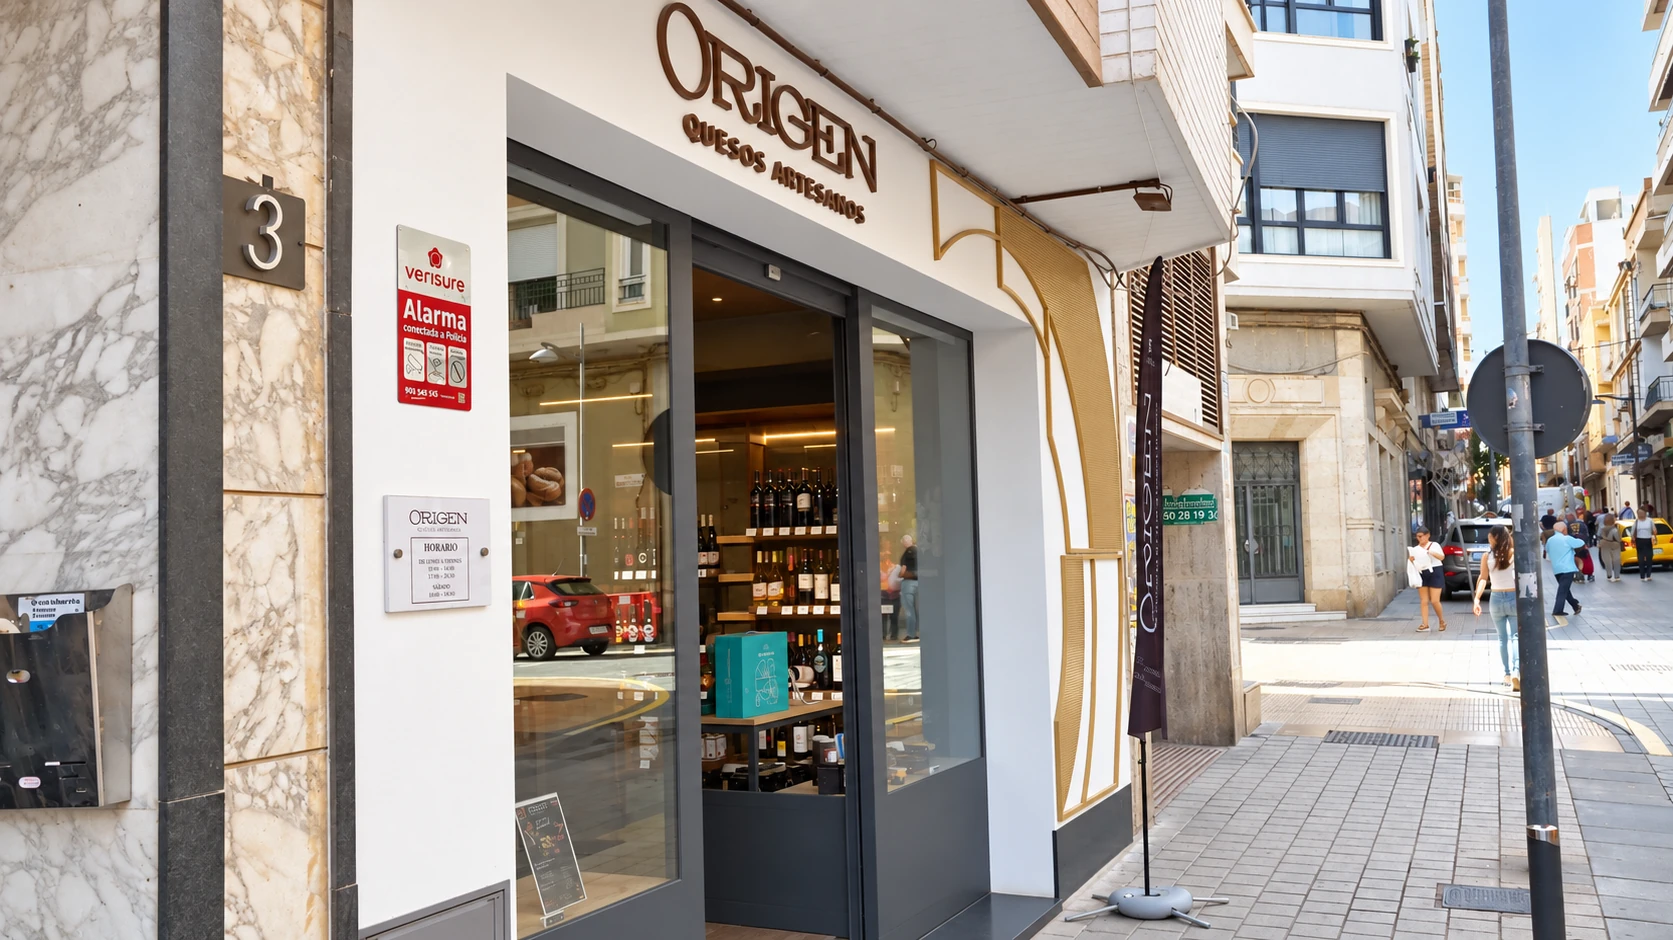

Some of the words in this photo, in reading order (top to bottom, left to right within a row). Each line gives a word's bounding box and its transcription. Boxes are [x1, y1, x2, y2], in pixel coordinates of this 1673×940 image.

[656, 2, 877, 193] ORIGEN
[682, 113, 766, 173] QUESOS
[770, 161, 866, 224] ARTESANOS
[243, 194, 283, 271] 3
[405, 265, 465, 293] verisure
[403, 298, 467, 331] Alarma
[409, 509, 468, 526] ORIGEN
[1177, 510, 1191, 521] 28
[1193, 509, 1205, 520] 19
[424, 542, 459, 552] HORARIO
